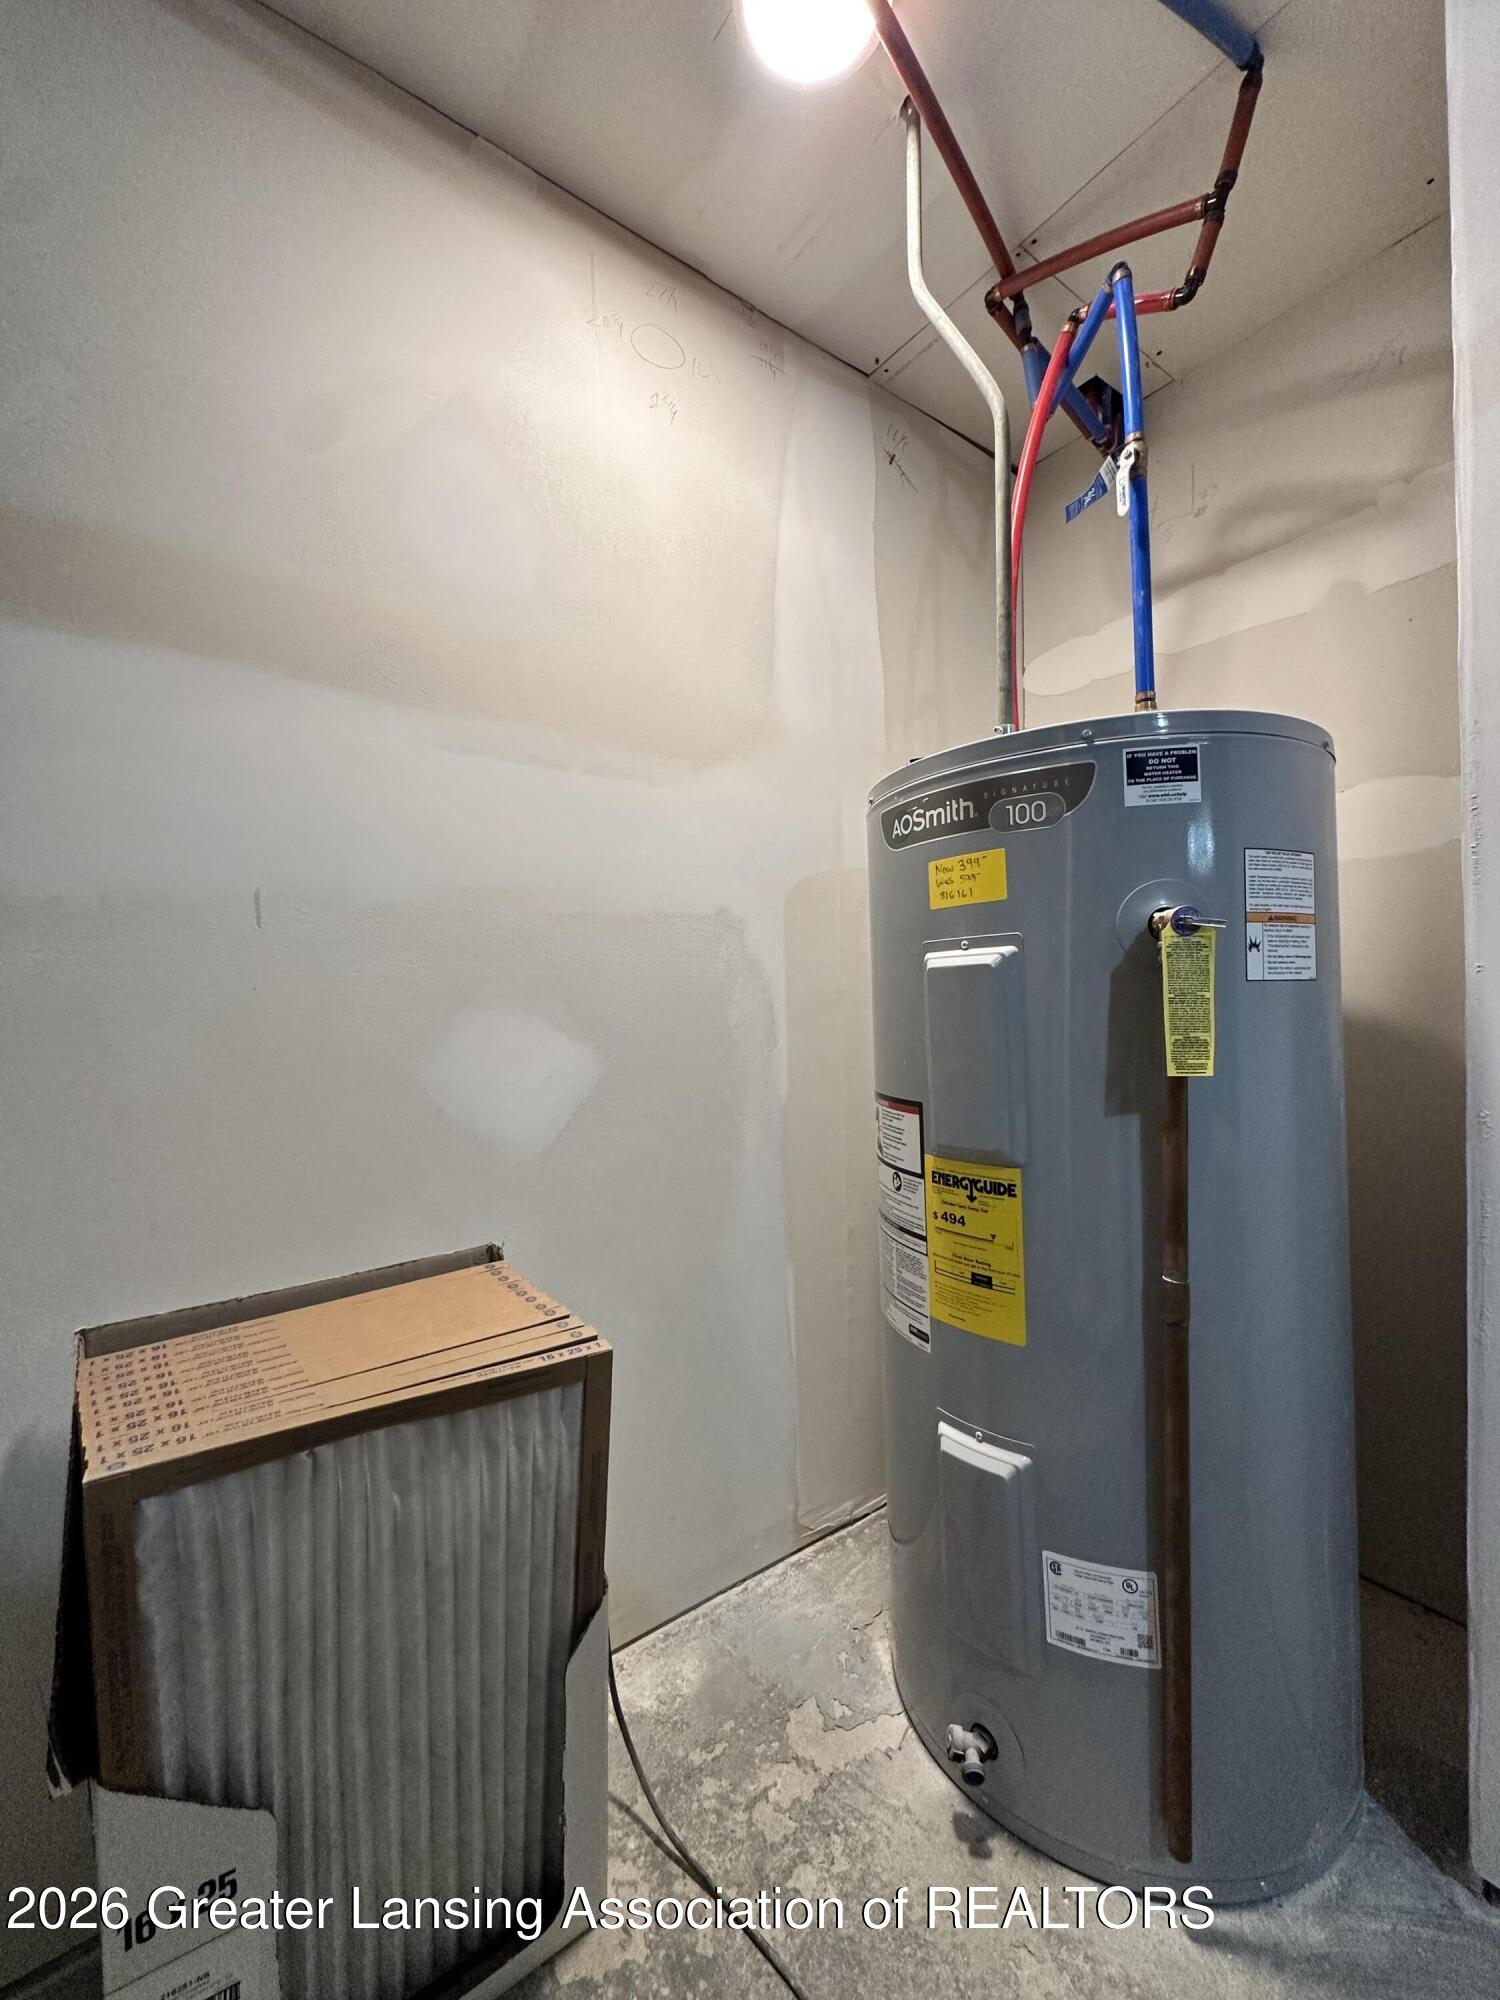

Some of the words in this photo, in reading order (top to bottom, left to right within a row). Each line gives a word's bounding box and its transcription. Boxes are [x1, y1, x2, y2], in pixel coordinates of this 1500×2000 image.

[984, 778, 1071, 800] SIGNATURE
[892, 798, 975, 839] AOSmith
[1005, 801, 1047, 826] 100
[936, 864, 954, 876] Now
[932, 1170, 1017, 1199] ENERGYGUIDE
[941, 1211, 966, 1227] 494
[539, 1354, 554, 1362] 16
[567, 1346, 583, 1355] 25
[176, 1434, 197, 1444] 16
[132, 1444, 155, 1456] 25
[117, 1910, 156, 1952] 16
[198, 1868, 238, 1915] 25
